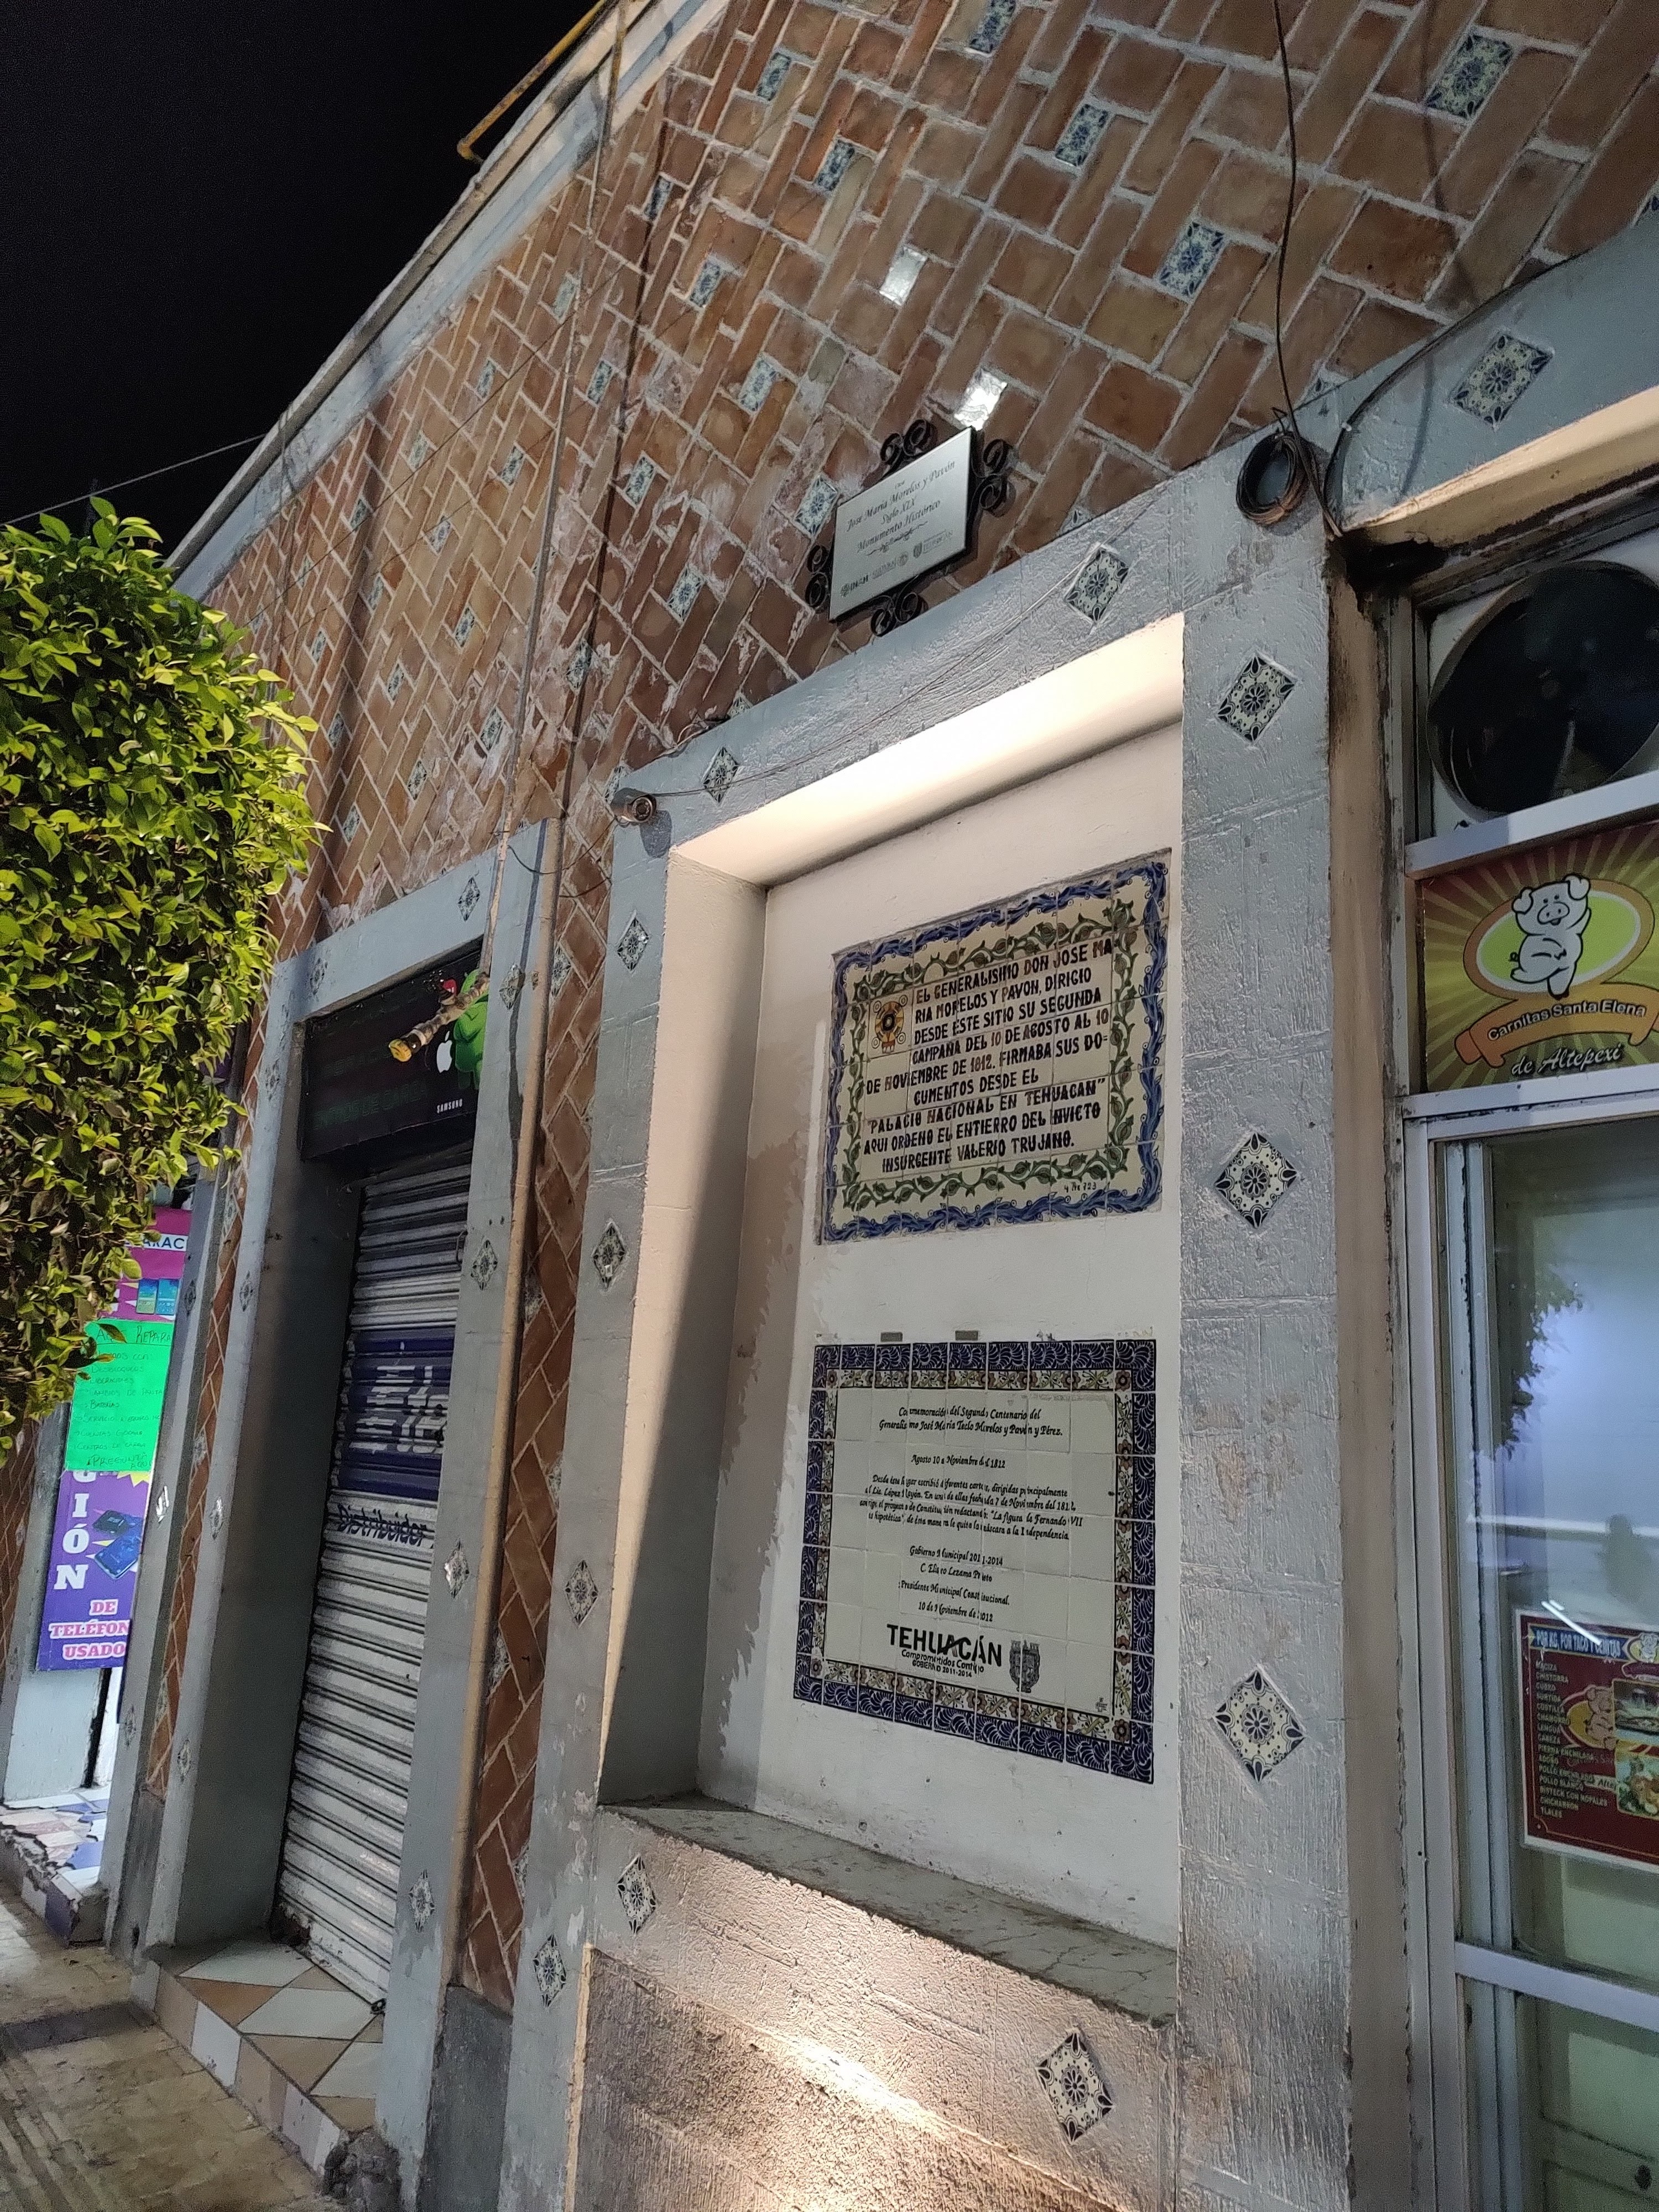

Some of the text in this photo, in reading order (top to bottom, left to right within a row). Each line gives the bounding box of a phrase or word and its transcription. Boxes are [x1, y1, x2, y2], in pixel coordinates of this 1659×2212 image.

[890, 481, 921, 504] Morelos
[857, 521, 902, 553] Monumento
[916, 938, 1112, 1004] EL GENERALISIMO DON JOSE MA
[915, 967, 1091, 1024] RIA MORELOS Y PAVON, DIRIGIO
[915, 987, 1102, 1045] DESDE ESTE SITIO SU SEGUNDA
[1488, 1000, 1646, 1041] Carnitas Santa Elena
[966, 1034, 987, 1052] DEL
[991, 1031, 1001, 1047] 10
[1005, 1026, 1020, 1045] DE
[1023, 1016, 1070, 1041] AGOSTO
[1074, 1013, 1091, 1030] AL
[1097, 1008, 1109, 1026] 10
[867, 1037, 1079, 1095] DE NOVIEMBRE DE 1812. FIRMABA SUS
[1511, 1042, 1622, 1076] de Altepexi
[914, 1068, 1039, 1106] CUMENTOS DESDE EL
[927, 1097, 994, 1124] NACIONAL
[1000, 1094, 1017, 1111] EN
[864, 1102, 1101, 1155] AQUI ORDENO EL ENTIERRO DEL INVICTO
[882, 1130, 1074, 1173] INSURGENTE VALERIO TRUJANO.
[950, 1405, 961, 1416] del
[990, 1409, 1027, 1420] Centenario
[1030, 1408, 1041, 1419] del
[919, 1421, 933, 1431] José
[975, 1421, 1002, 1433] Morelos
[1003, 1426, 1008, 1437] y
[1034, 1427, 1039, 1438] y
[911, 1455, 931, 1465] Agosto
[933, 1456, 940, 1464] 10
[946, 1454, 978, 1465] Noviembre
[990, 1459, 1005, 1468] 1812
[873, 1474, 889, 1484] Desde
[918, 1478, 939, 1488] escribió
[940, 1478, 968, 1490] diferentes
[992, 1483, 1018, 1496] dirigidas
[1019, 1485, 1068, 1499] principalmente
[879, 1499, 883, 1508] el
[909, 1501, 915, 1511] de
[1002, 1511, 1022, 1524] figura
[1034, 1514, 1066, 1526] Fernando
[1070, 1516, 1083, 1527] VII
[925, 1491, 933, 1499] En
[947, 1491, 953, 1500] de
[955, 1492, 968, 1502] ellas
[995, 1498, 999, 1506] 7
[1000, 1498, 1008, 1506] de
[1009, 1497, 1044, 1509] Noviembre
[1045, 1499, 1056, 1510] del
[907, 1514, 914, 1524] de
[927, 1519, 949, 1527] manera
[950, 1517, 955, 1527] le
[1013, 1525, 1019, 1536] la
[1021, 1526, 1069, 1540] Independencia
[910, 1545, 935, 1557] Gobierno
[937, 1548, 969, 1562] Municipal
[948, 1567, 972, 1578] Lezama
[899, 1580, 929, 1593] Presidente
[930, 1583, 963, 1599] Municipal
[90, 1599, 118, 1615] DE
[919, 1601, 926, 1610] 10
[926, 1601, 933, 1611] de
[934, 1603, 967, 1617] Noviembre
[968, 1608, 976, 1619] de
[63, 1642, 126, 1660] USADO
[886, 1624, 1001, 1667] TEHUACÁN
[1536, 1631, 1548, 1647] POR
[1561, 1633, 1572, 1650] POR
[1573, 1635, 1588, 1652] TACO
[901, 1649, 955, 1668] Comprometidos
[912, 1660, 972, 1678] GOBIERNO 2011-2014
